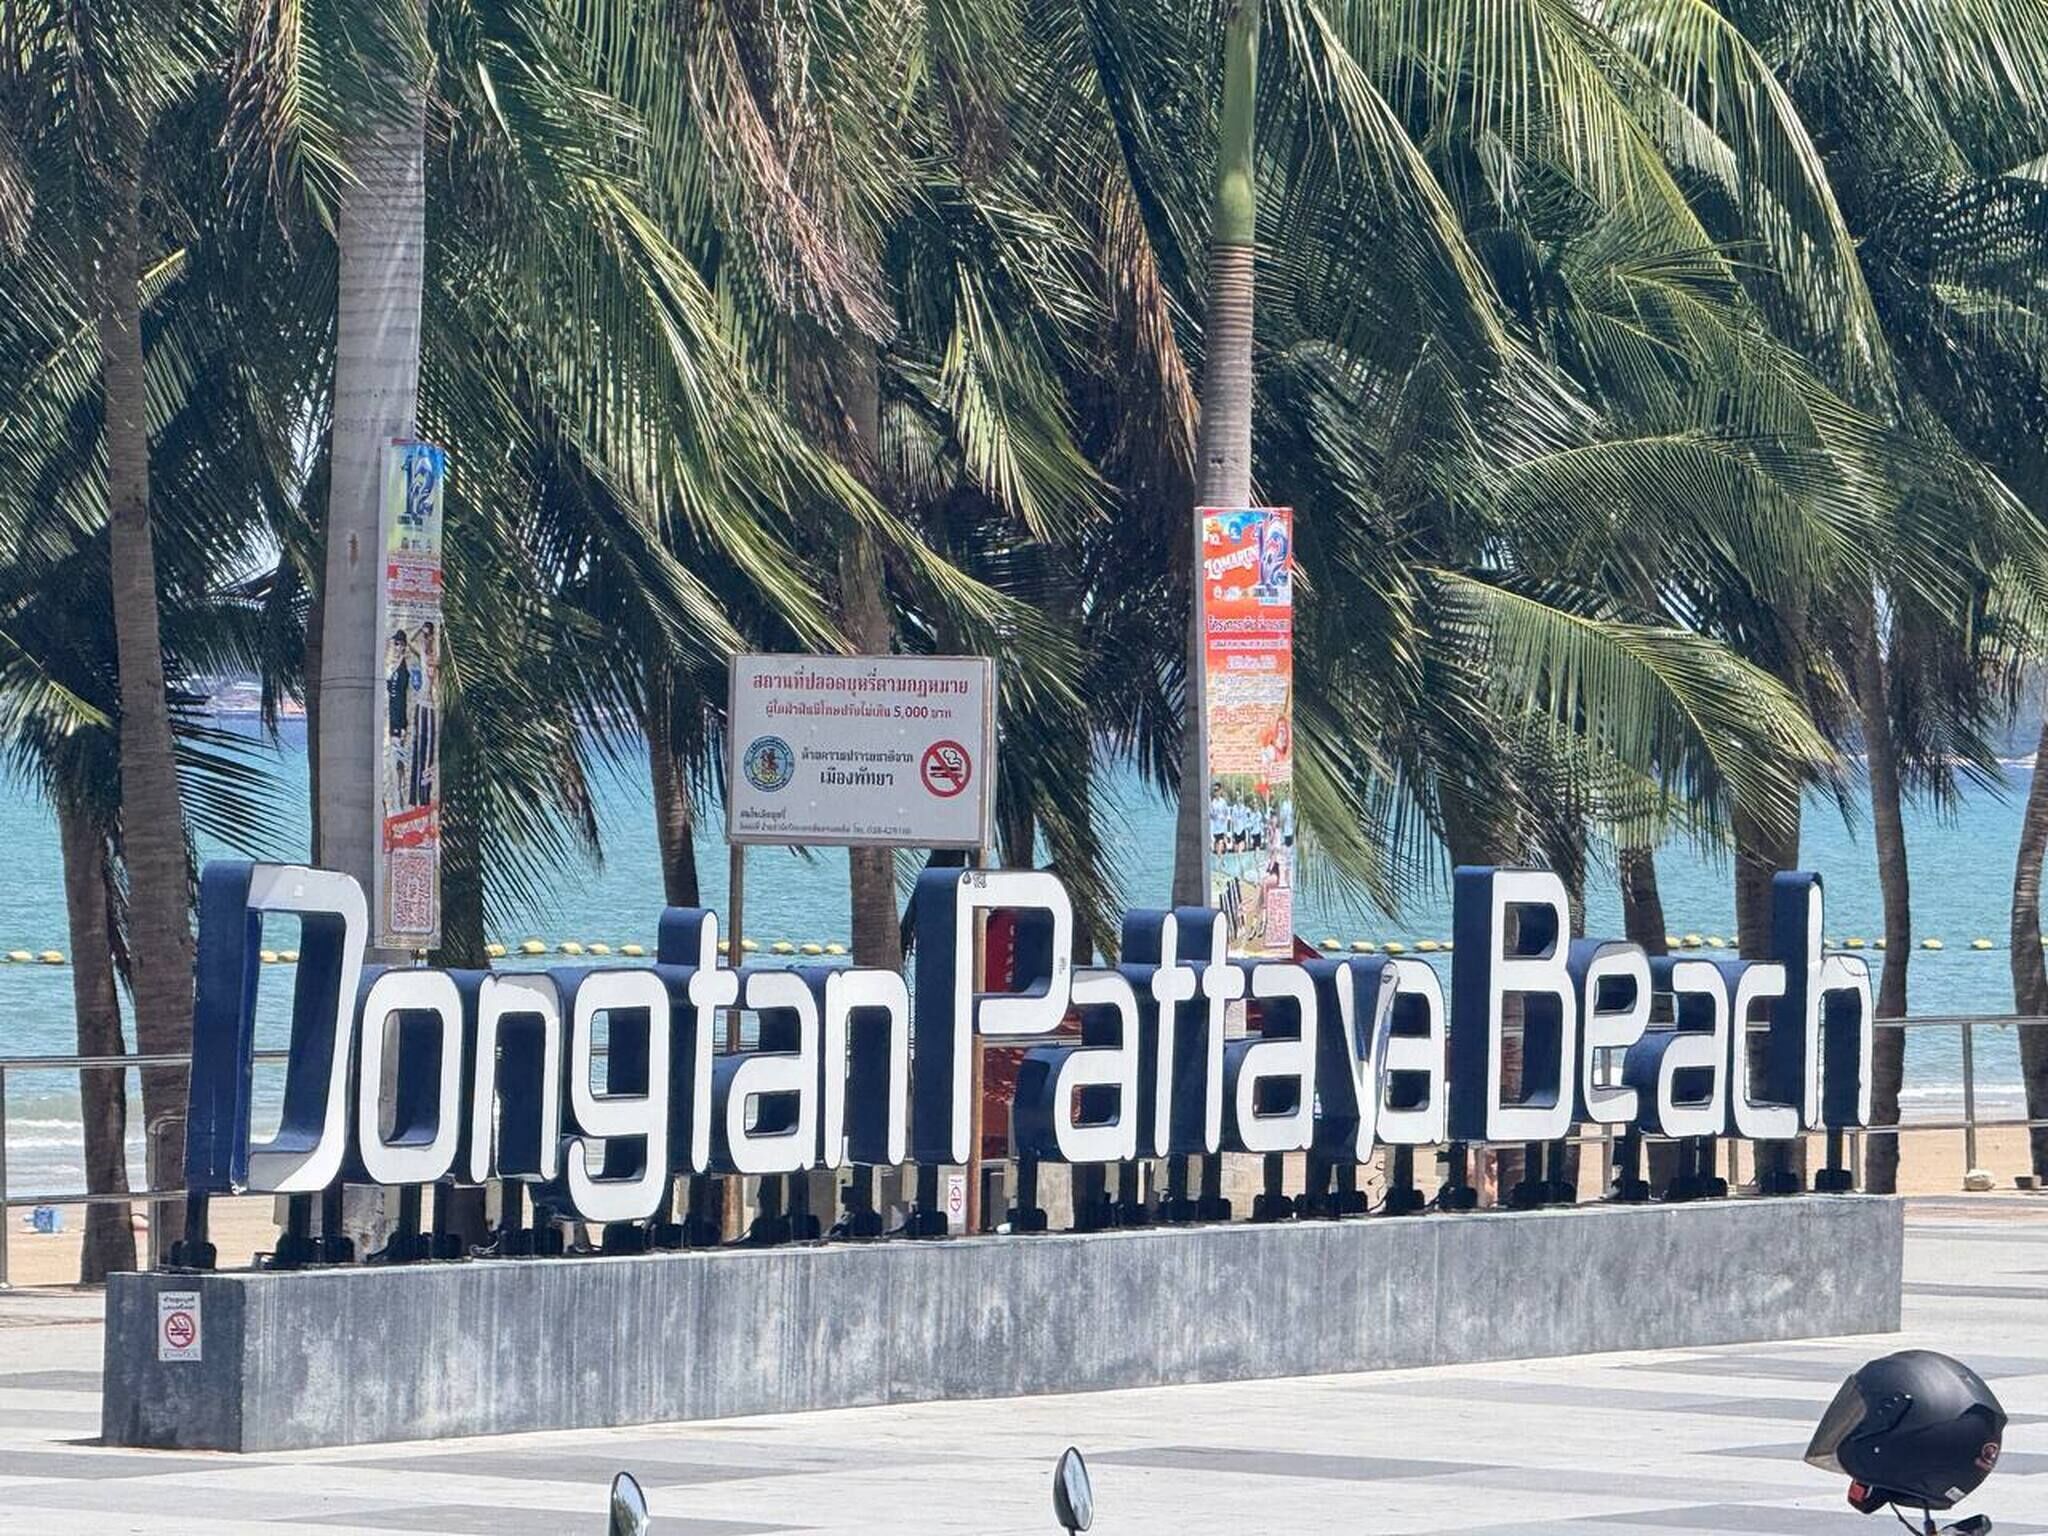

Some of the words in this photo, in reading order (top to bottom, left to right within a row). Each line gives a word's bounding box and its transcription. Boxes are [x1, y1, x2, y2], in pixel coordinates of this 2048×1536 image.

[893, 705, 929, 719] 5,000
[820, 766, 894, 786] เมืองพัทยา
[230, 862, 909, 1222] Dongtan
[951, 870, 1447, 1165] Pattaya
[1485, 870, 1873, 1140] Beach
